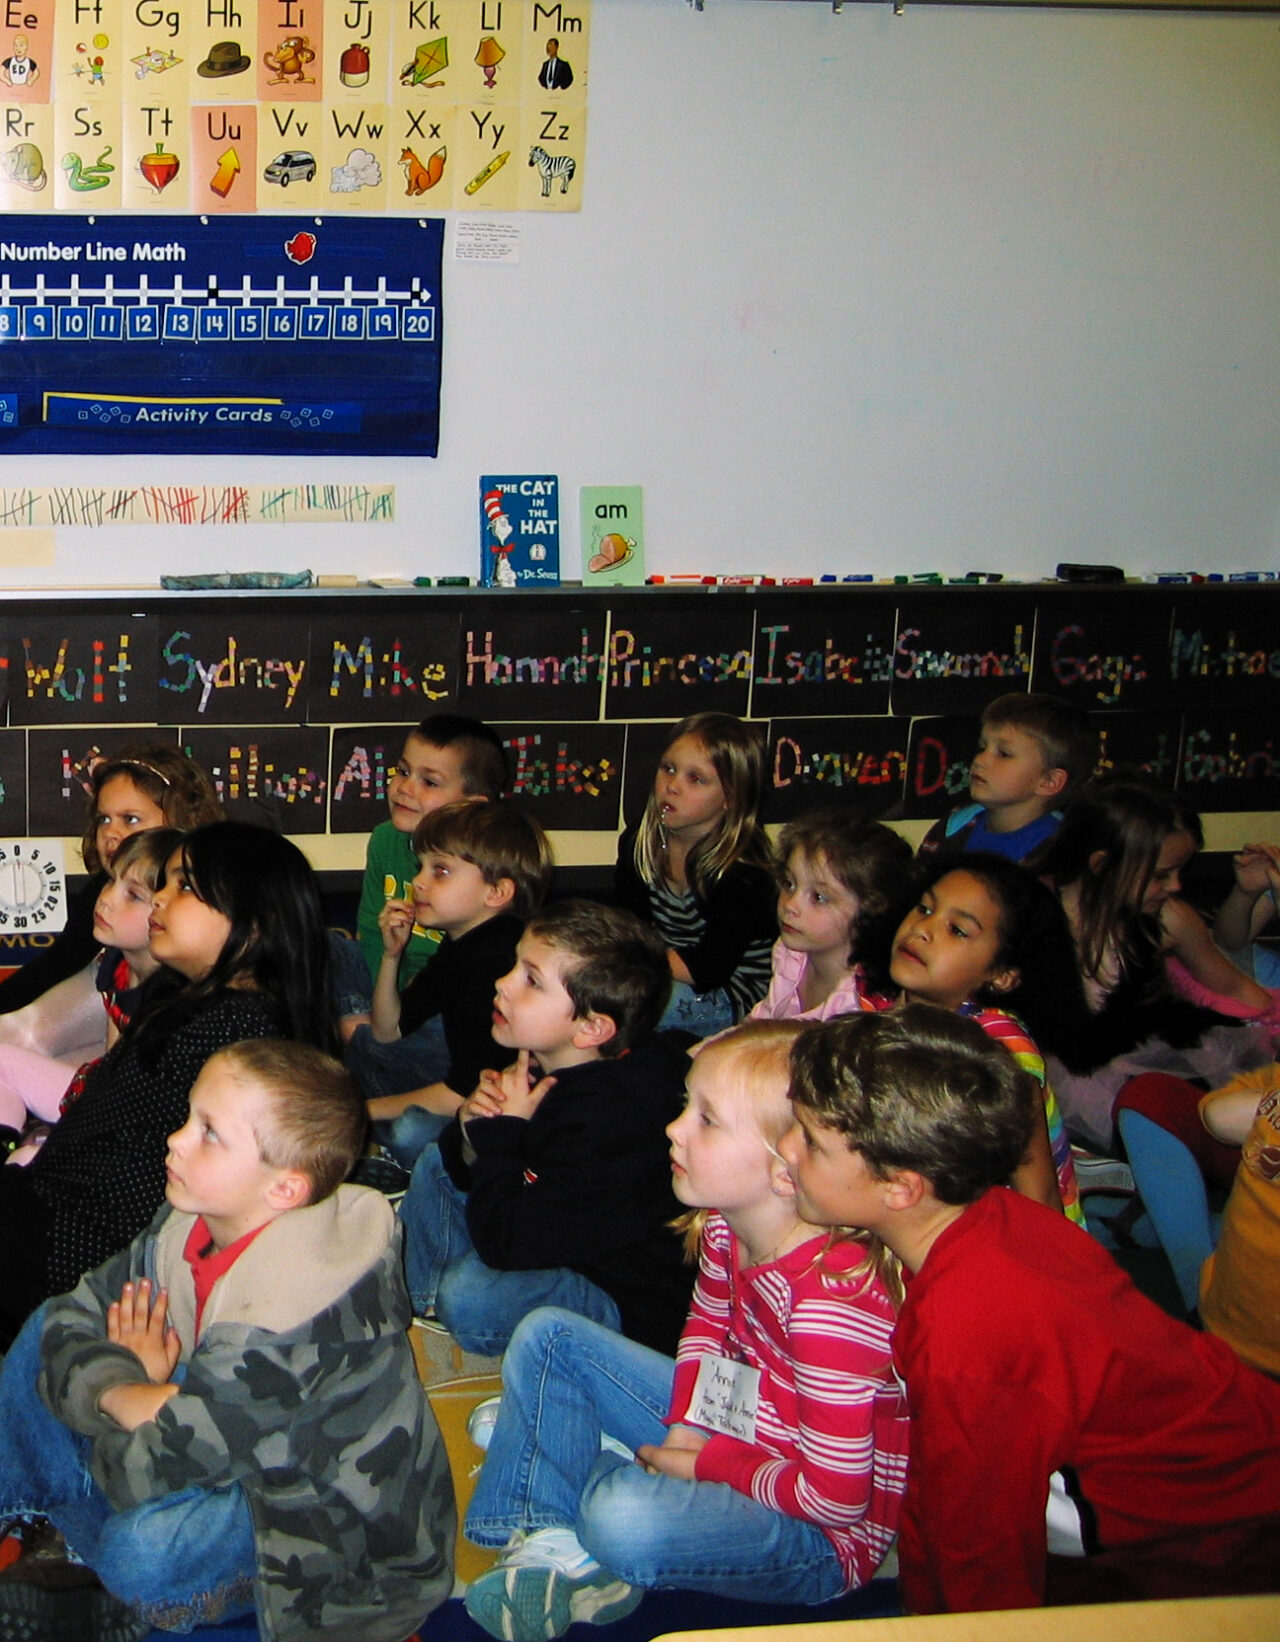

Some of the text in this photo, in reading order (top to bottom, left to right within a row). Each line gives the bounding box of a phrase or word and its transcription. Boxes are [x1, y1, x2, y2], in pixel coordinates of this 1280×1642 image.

[5, 0, 38, 29] Ee
[74, 0, 102, 24] Ff
[135, 0, 180, 37] Gg
[207, 1, 241, 28] Hh
[278, 0, 304, 28] Ii
[344, 1, 373, 39] Jj
[409, 1, 440, 29] Kk
[480, 1, 501, 30] Ll
[533, 2, 581, 33] Mm
[5, 109, 35, 137] Rr
[74, 109, 102, 136] Ss
[140, 109, 173, 136] Tt
[207, 112, 241, 141] Uu
[272, 109, 308, 137] Vv
[332, 111, 384, 139] Ww
[405, 111, 440, 139] Xx
[471, 111, 504, 149] Yy
[540, 111, 569, 140] Zz
[1, 243, 186, 261] Number Line Math
[0, 315, 9, 331] 8
[34, 315, 45, 331] 9
[66, 315, 83, 332] 10
[101, 316, 114, 332] 11
[135, 316, 152, 332] 12
[172, 316, 189, 331] 13
[206, 315, 223, 332] 14
[240, 316, 256, 332] 15
[274, 316, 290, 332] 16
[307, 315, 324, 331] 17
[341, 315, 358, 331] 18
[375, 315, 391, 331] 19
[407, 316, 429, 332] 20
[135, 407, 272, 423] Activity Cards
[496, 481, 555, 496] THE CAT
[528, 509, 548, 517] THE
[595, 505, 627, 518] am
[520, 520, 557, 534] HAT
[159, 631, 305, 712] Sydney
[330, 637, 449, 701] Mike
[14, 845, 20, 856] 0
[31, 850, 40, 859] 5
[43, 862, 56, 874] 10
[50, 881, 60, 891] 15
[44, 897, 58, 911] 20
[14, 917, 27, 927] 30
[32, 911, 46, 923] 25
